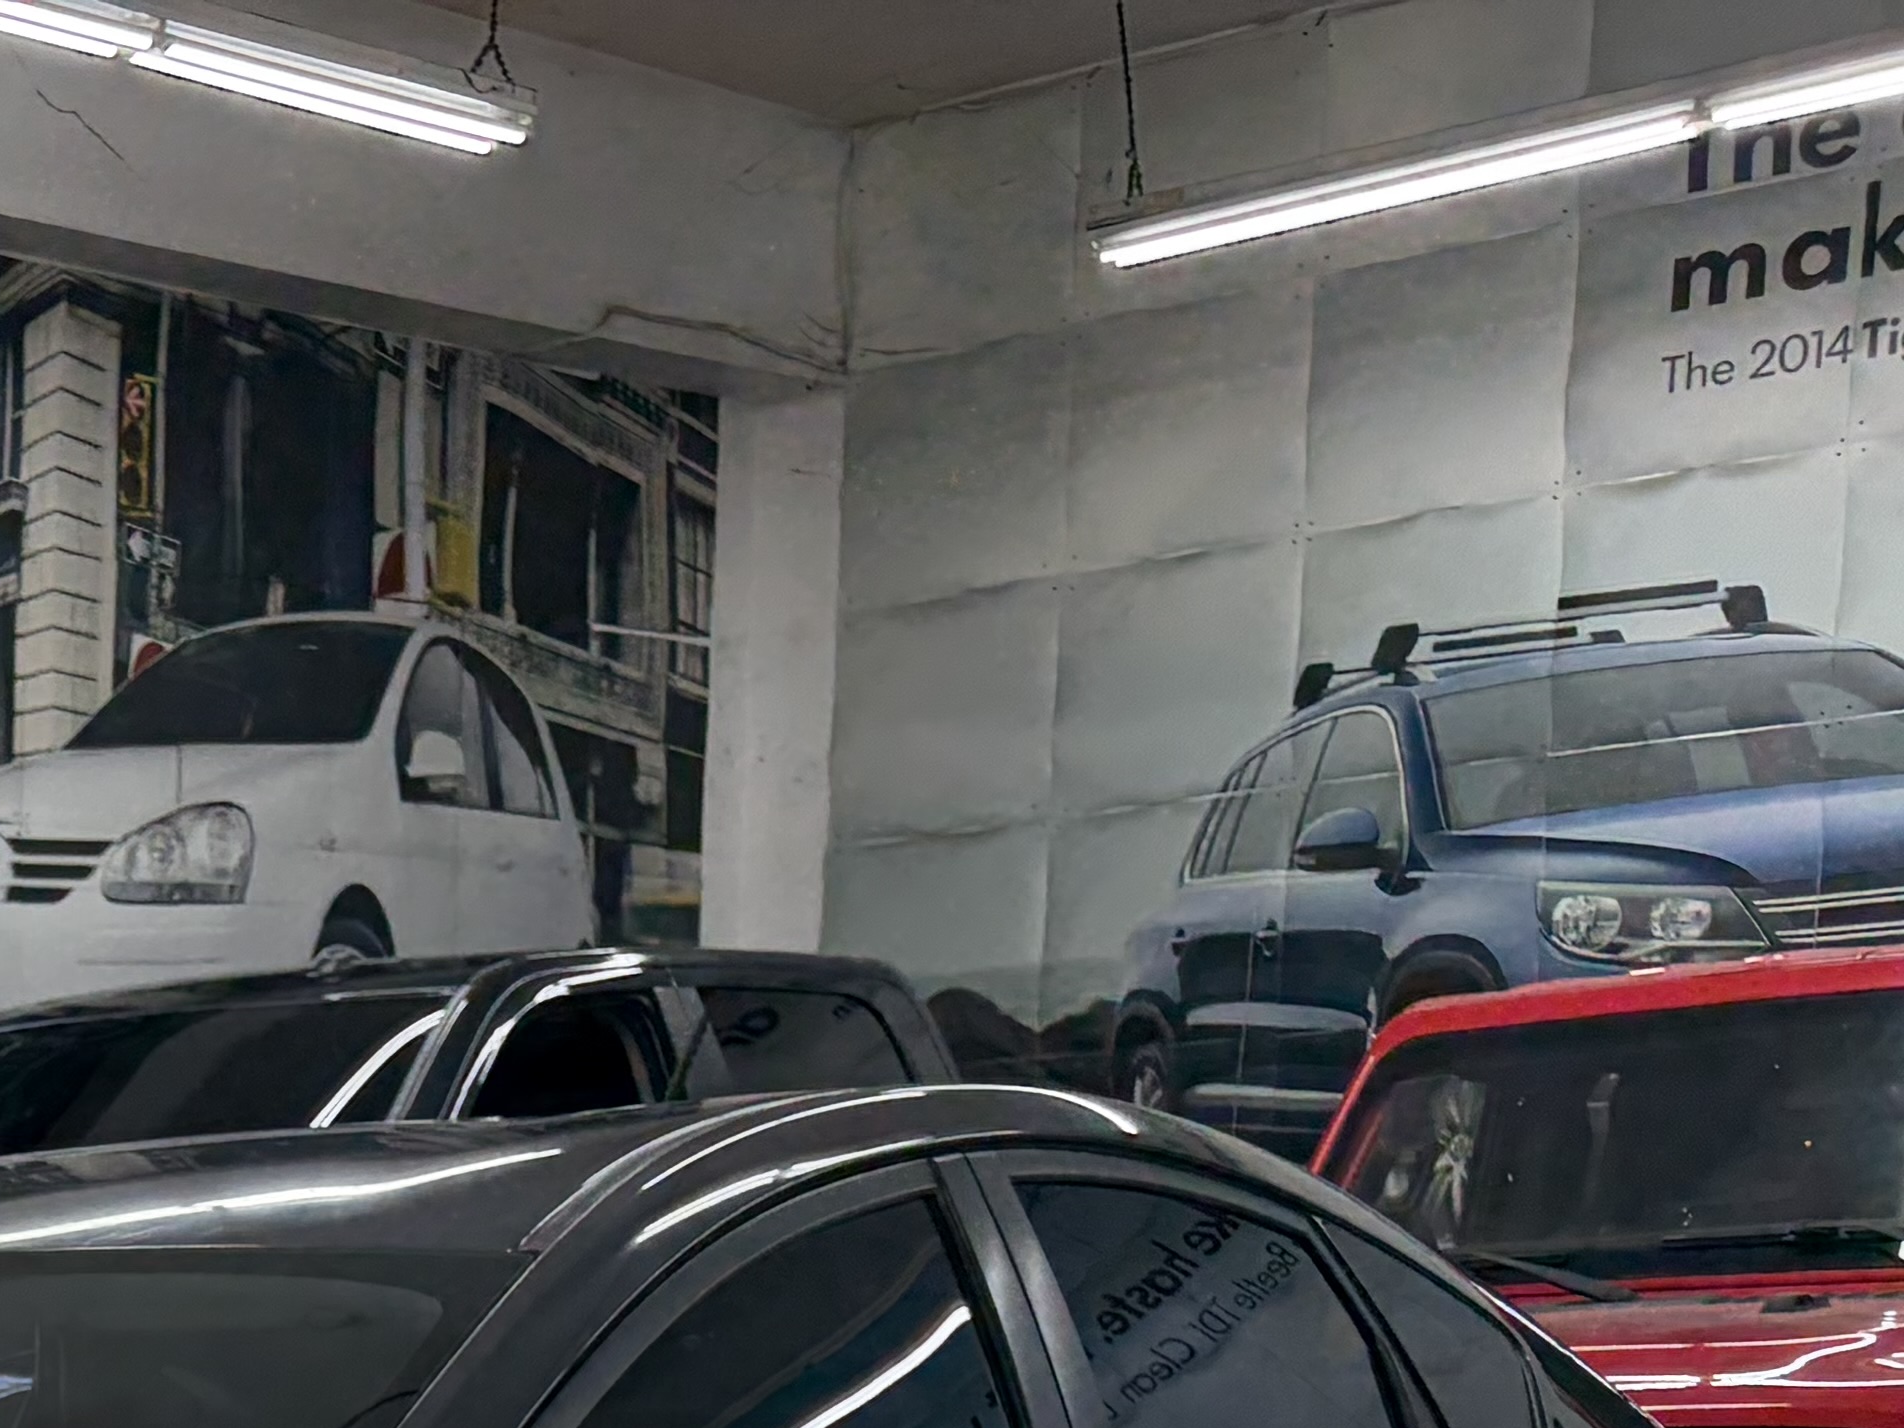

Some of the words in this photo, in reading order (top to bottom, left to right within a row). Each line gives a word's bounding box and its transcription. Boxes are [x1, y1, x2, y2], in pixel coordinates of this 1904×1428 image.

[1661, 352, 1735, 393] The
[1749, 325, 1853, 379] 2014
[1862, 317, 1904, 361] Ti
